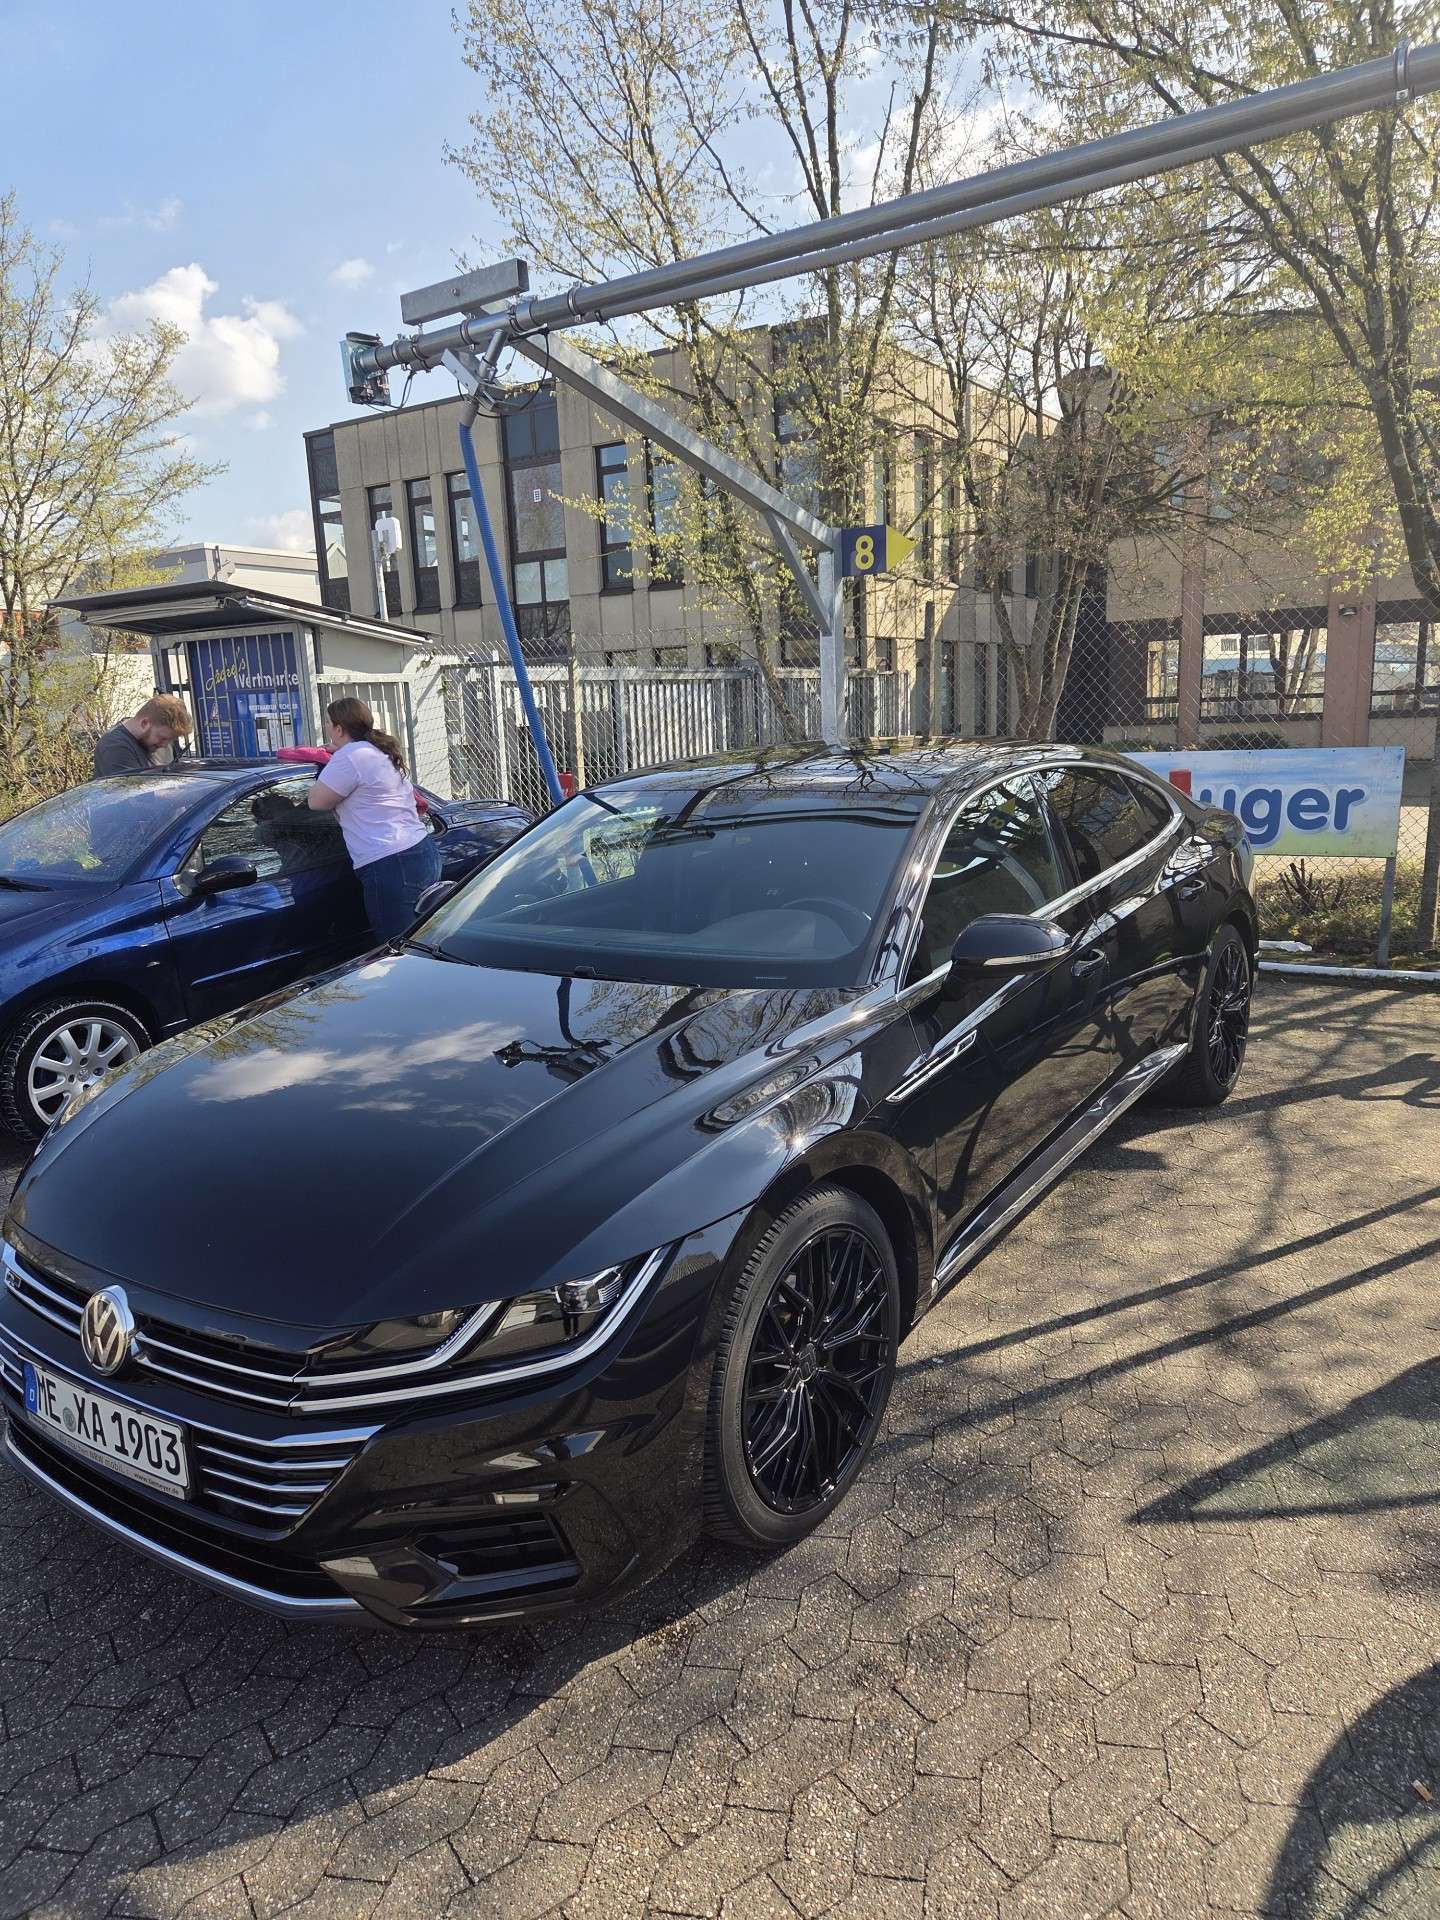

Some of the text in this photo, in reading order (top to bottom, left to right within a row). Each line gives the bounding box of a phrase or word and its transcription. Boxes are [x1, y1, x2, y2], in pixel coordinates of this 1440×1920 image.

[855, 535, 875, 570] 8
[84, 1291, 127, 1371] VW
[29, 1389, 35, 1402] D
[36, 1371, 62, 1425] ME
[73, 1393, 107, 1447] XA
[111, 1411, 181, 1476] 1903
